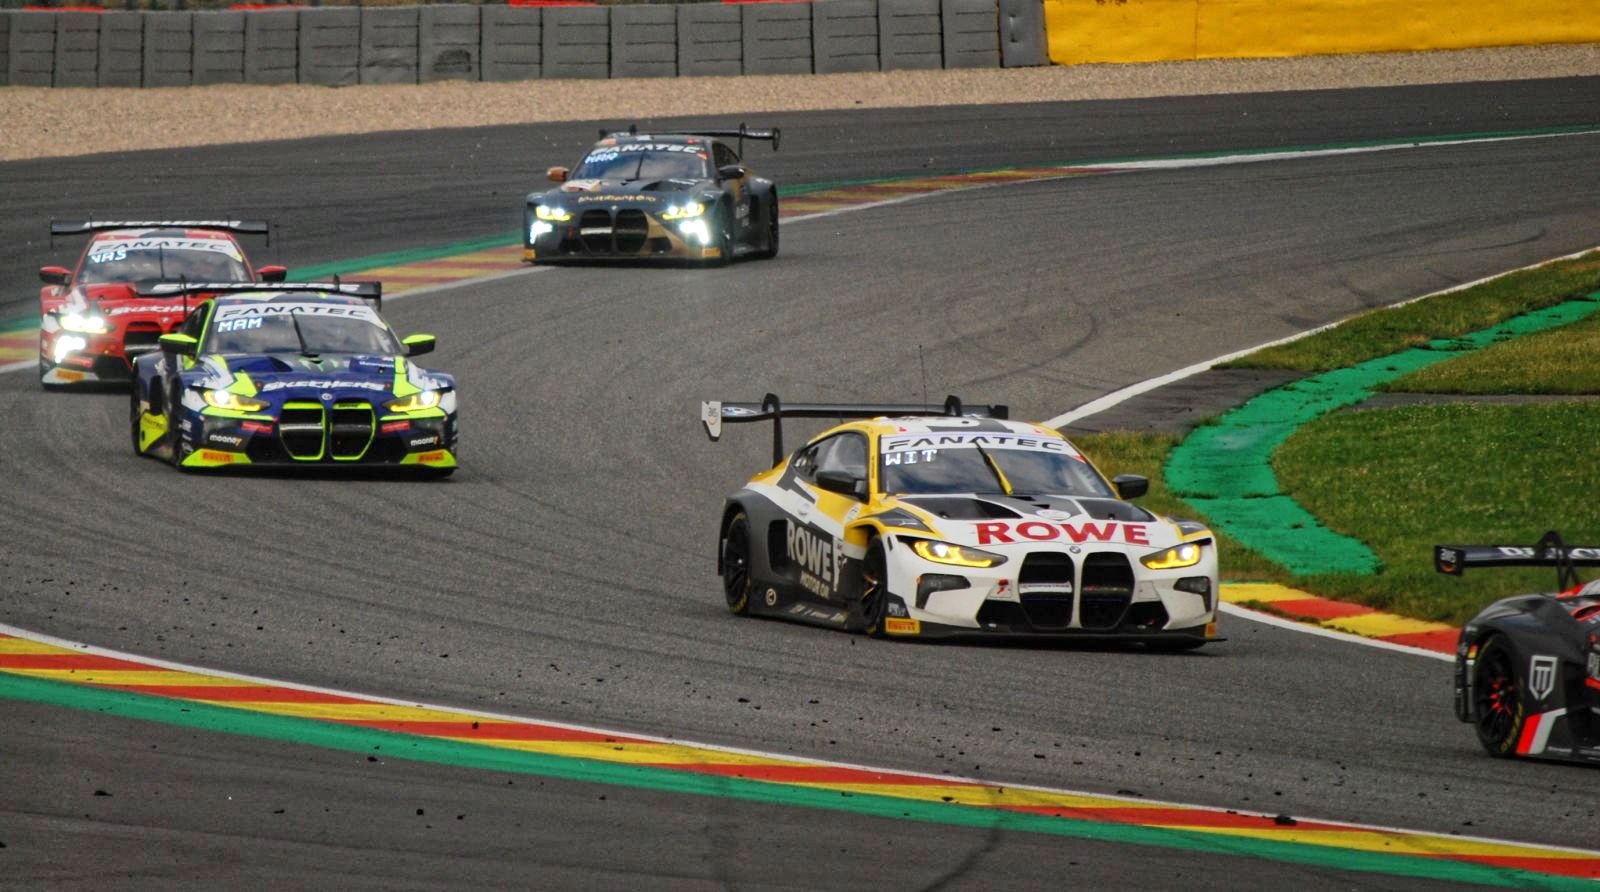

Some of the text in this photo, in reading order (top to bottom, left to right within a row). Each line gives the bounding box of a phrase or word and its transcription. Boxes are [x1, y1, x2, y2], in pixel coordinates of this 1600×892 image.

[591, 144, 700, 155] FANATEC
[97, 241, 227, 252] FANATEC
[223, 306, 367, 318] FANATEC
[217, 317, 263, 333] MAM
[889, 436, 1063, 451] FANATEC
[885, 449, 937, 466] WIT
[976, 521, 1150, 545] ROWE
[786, 517, 832, 582] ROWE
